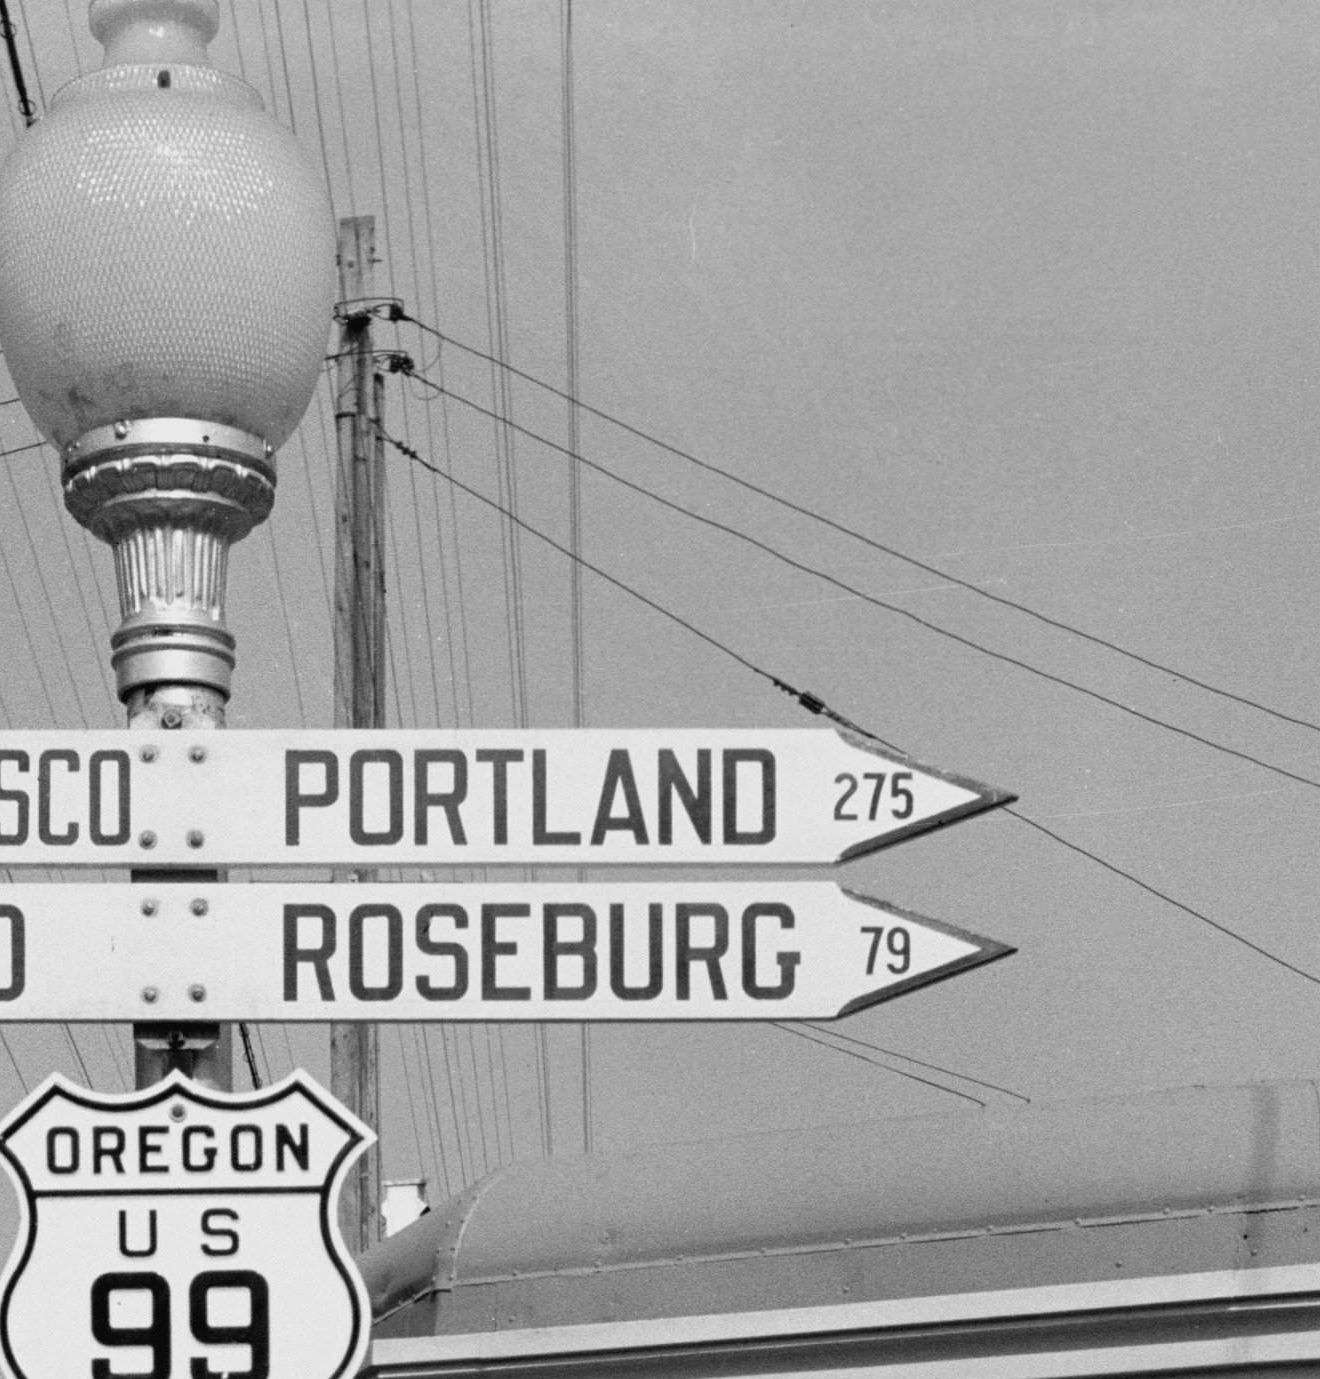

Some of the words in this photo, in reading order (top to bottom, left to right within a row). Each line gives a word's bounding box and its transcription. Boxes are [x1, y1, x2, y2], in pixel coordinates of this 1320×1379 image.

[284, 748, 778, 846] PORTLAND
[832, 771, 915, 822] 275
[282, 902, 802, 1002] ROSEBURG
[859, 926, 912, 976] 79
[45, 1122, 310, 1175] OREGON
